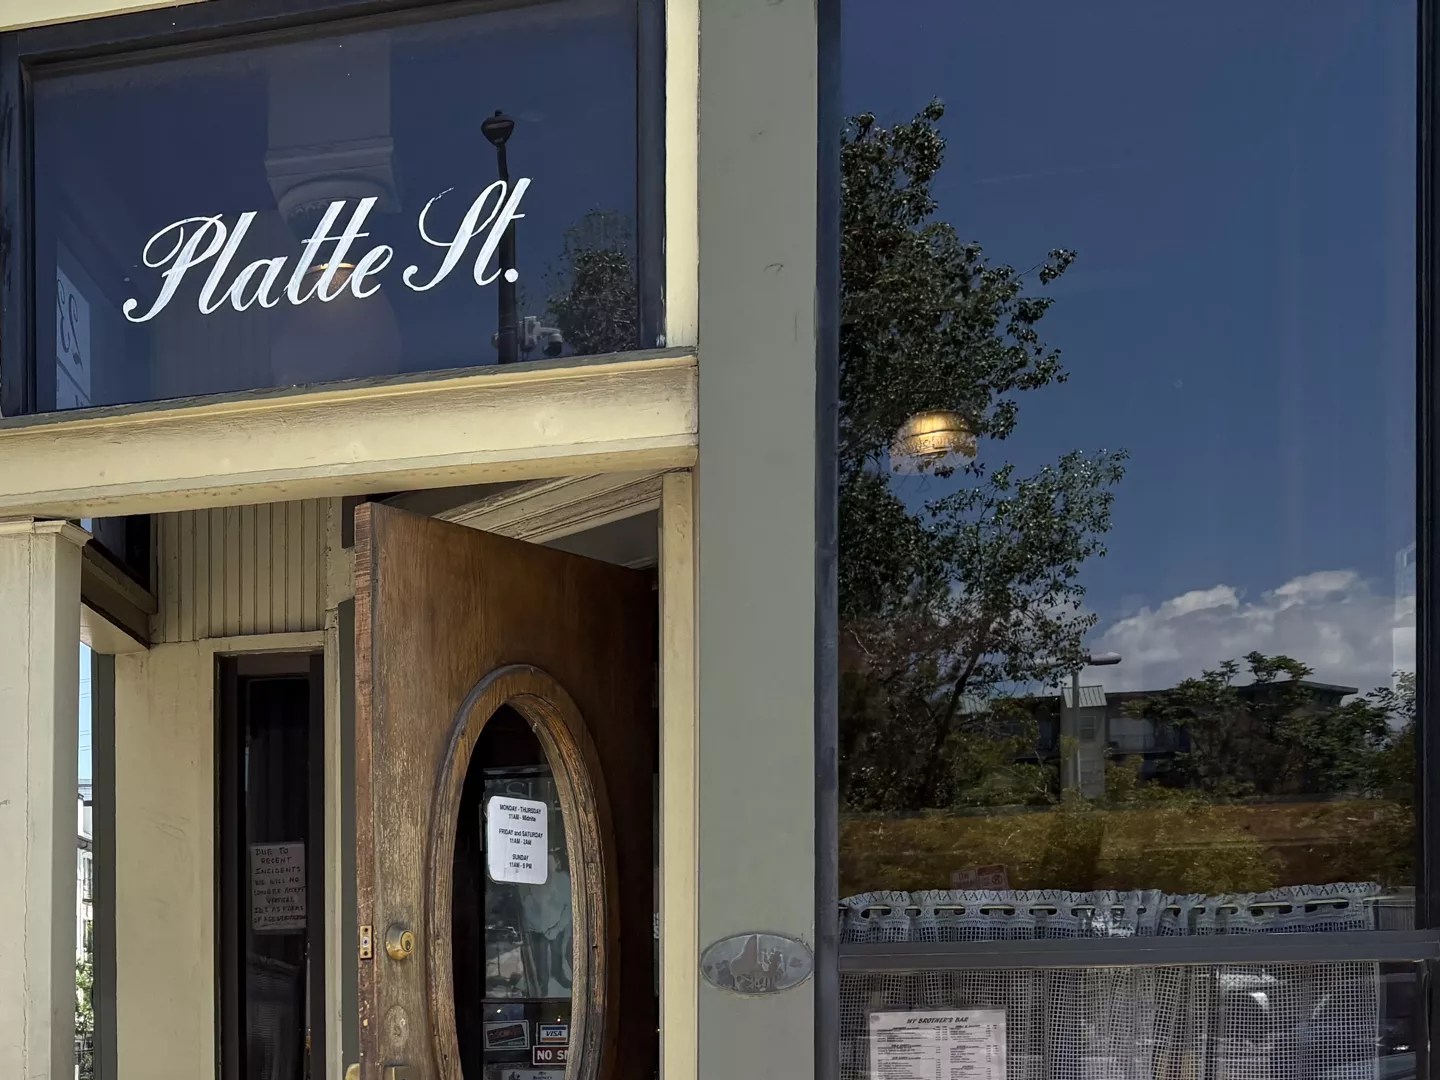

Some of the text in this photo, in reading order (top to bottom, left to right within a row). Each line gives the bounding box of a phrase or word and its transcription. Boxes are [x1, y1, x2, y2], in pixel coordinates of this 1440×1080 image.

[124, 177, 532, 323] Platte St.
[500, 804, 517, 812] MONDAY
[520, 806, 541, 814] THURSDAY
[256, 848, 272, 856] DUE
[255, 866, 301, 874] INCIDENTS
[537, 1050, 552, 1060] NO
